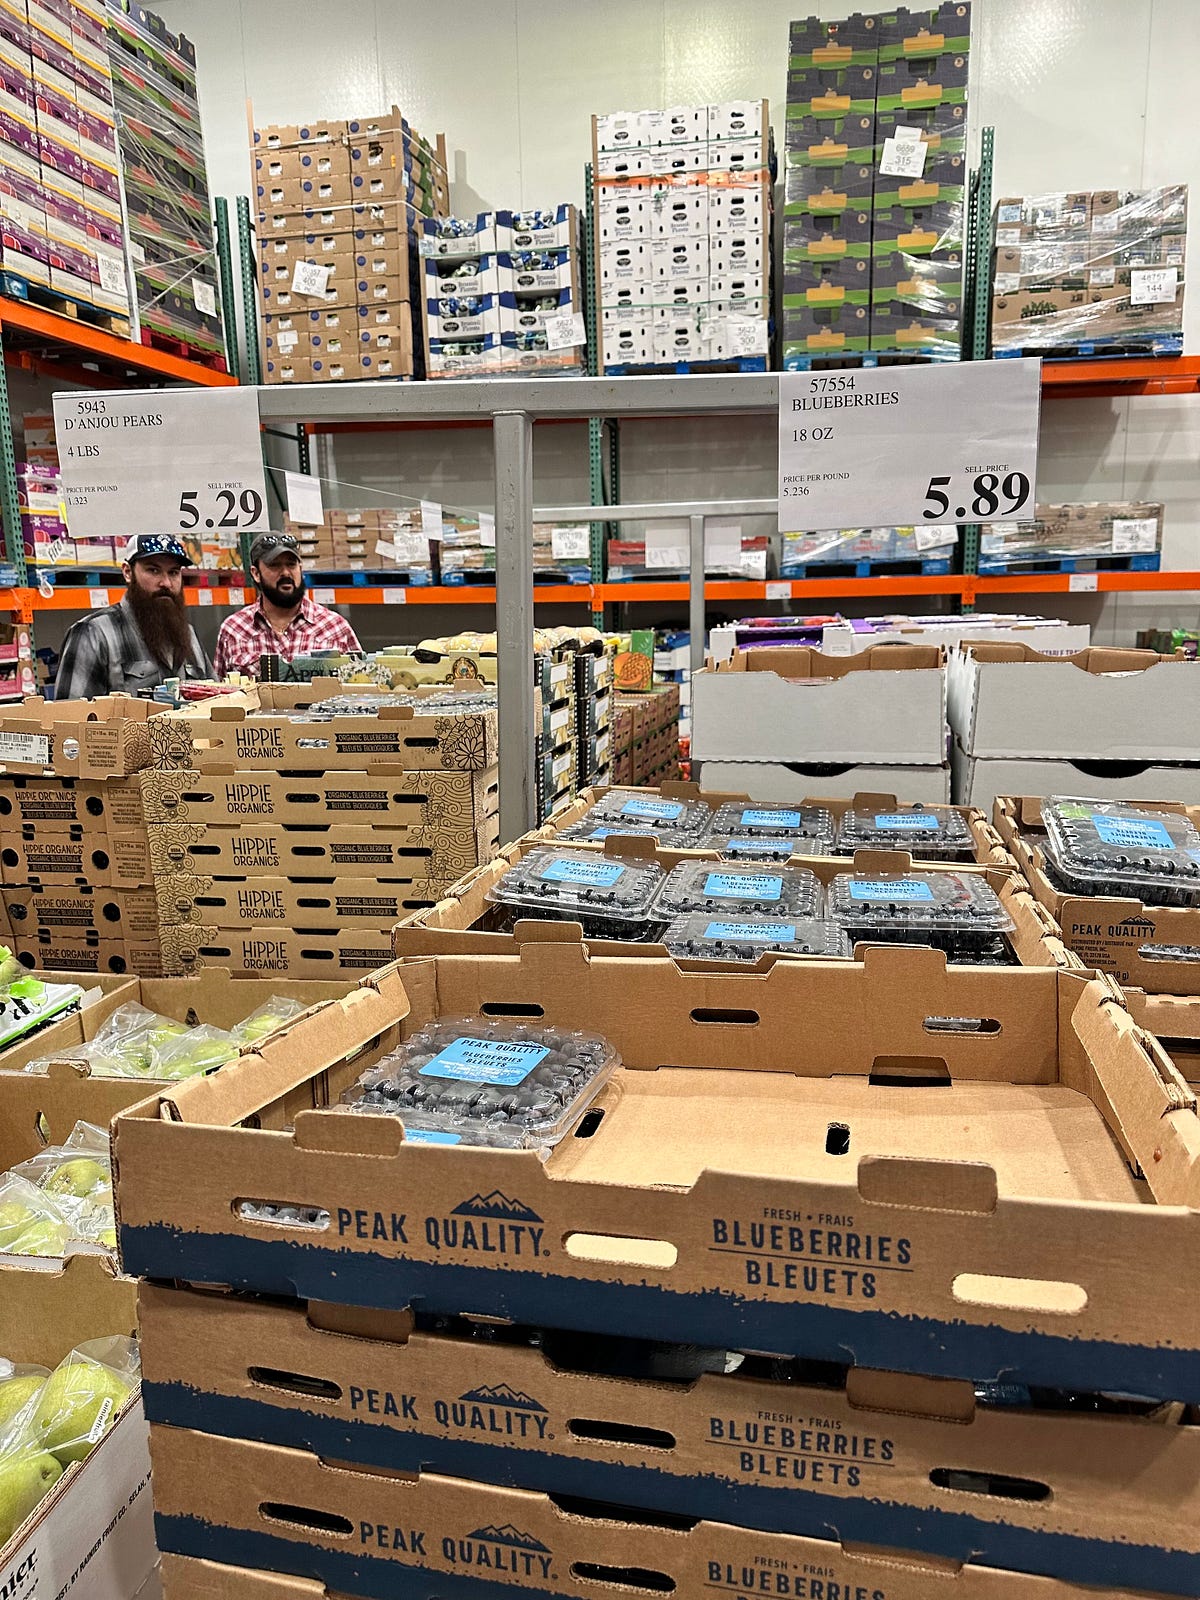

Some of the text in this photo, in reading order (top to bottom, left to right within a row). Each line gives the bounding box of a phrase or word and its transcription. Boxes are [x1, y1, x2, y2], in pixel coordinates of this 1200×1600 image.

[1147, 284, 1162, 292] 144
[810, 376, 855, 393] 57554
[77, 401, 106, 414] 5943
[792, 391, 899, 411] BLUEBERRIES
[65, 414, 163, 430] D'ANJOU PEARS
[793, 427, 834, 442] 18 OZ
[67, 445, 100, 457] 4 LBS
[823, 473, 850, 481] POUND
[965, 464, 1009, 474] SELL PRICE
[207, 481, 243, 490] SELL PRICE
[783, 486, 810, 497] 5.236
[67, 496, 88, 506] 1.323
[922, 471, 1030, 519] 5.89
[179, 488, 263, 529] 5.29
[1072, 923, 1156, 938] PEAK QUALITY
[461, 1039, 544, 1055] PEAK QUALITY
[462, 1051, 524, 1063] BLUEBERRIES
[465, 1058, 507, 1068] BLEUETS
[763, 1207, 854, 1227] FRESH FRAIS
[337, 1207, 545, 1257] PEAK QUALITY
[713, 1218, 912, 1265] BLUEBERRIES
[746, 1259, 877, 1298] BLEUETS
[349, 1385, 549, 1439] PEAK QUALITY
[758, 1410, 843, 1430] FRESH FRAIS
[710, 1417, 895, 1461] BLUEBERRIES
[740, 1451, 861, 1487] BLEUETS
[70, 1568, 79, 1585] BY
[79, 1538, 102, 1573] RAINIER
[101, 1515, 118, 1541] FRUIT
[359, 1521, 553, 1579] PEAK QUALITY
[754, 1556, 835, 1578] FRESH FRAIS
[708, 1560, 886, 1600] BLUEBERRIES
